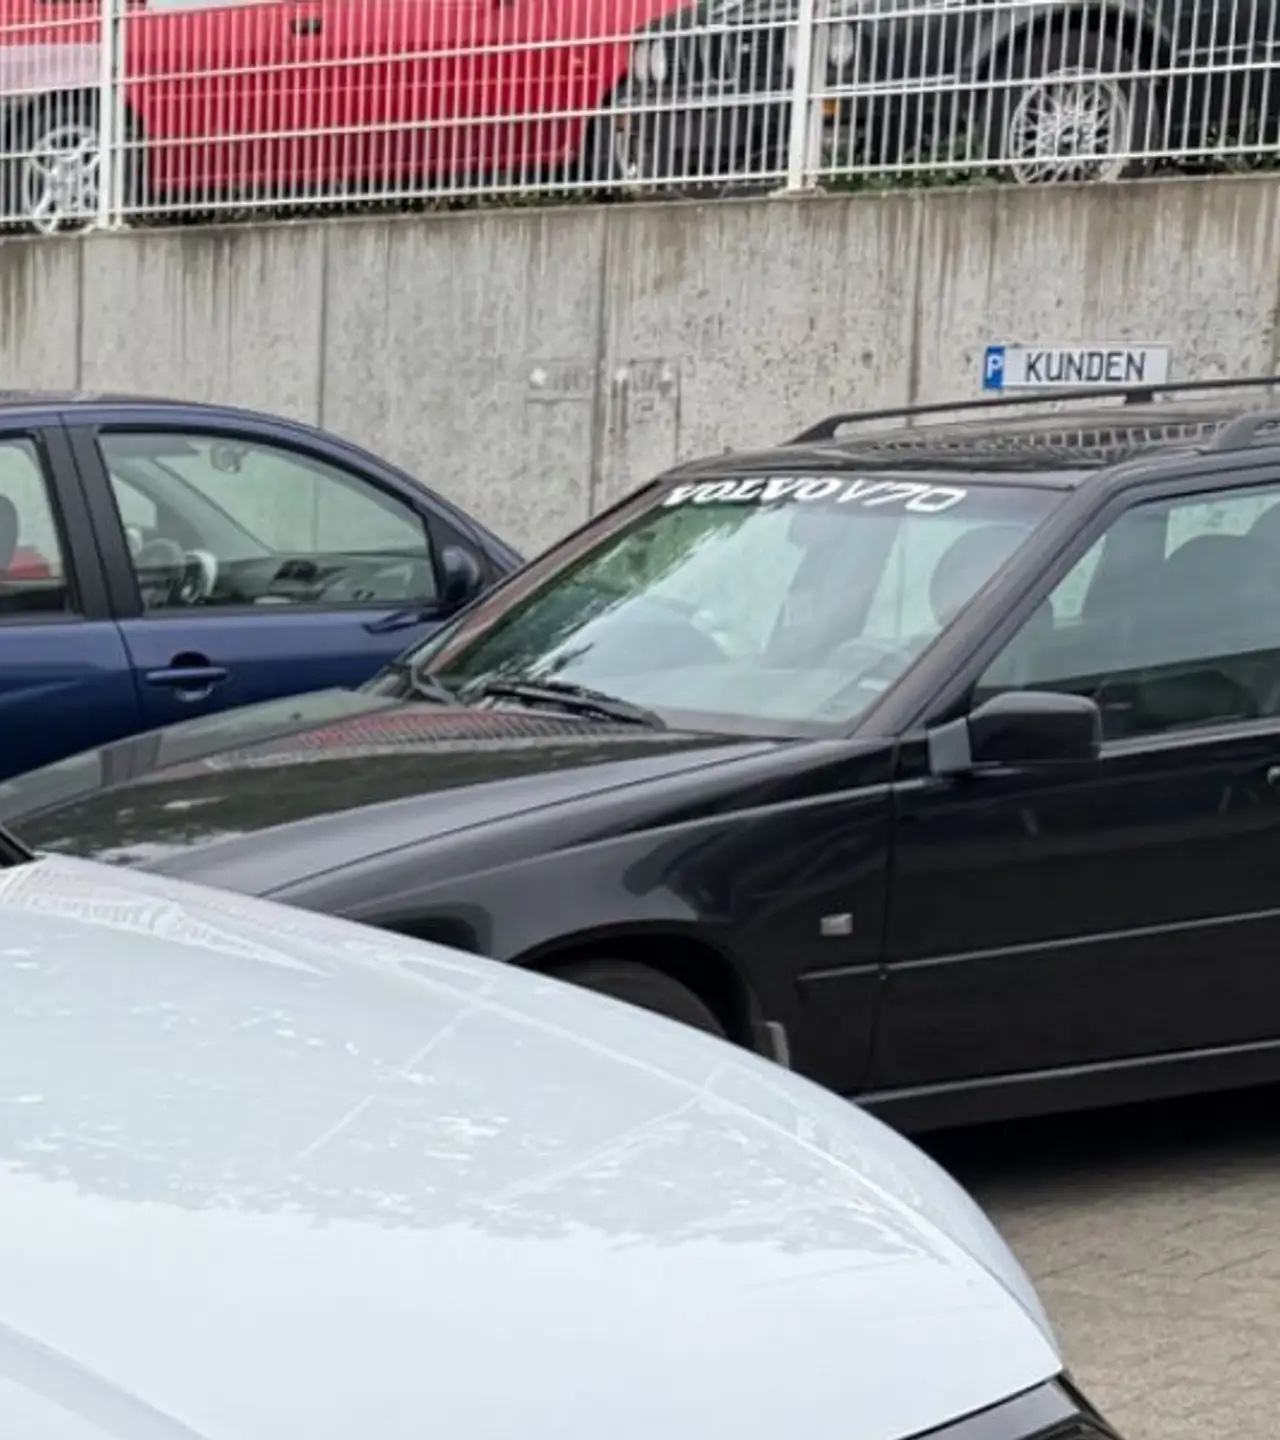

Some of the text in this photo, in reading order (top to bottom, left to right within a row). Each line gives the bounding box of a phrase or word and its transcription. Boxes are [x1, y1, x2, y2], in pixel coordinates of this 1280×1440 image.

[1025, 352, 1146, 382] KUNDEN
[664, 477, 968, 512] VOLVO V70
